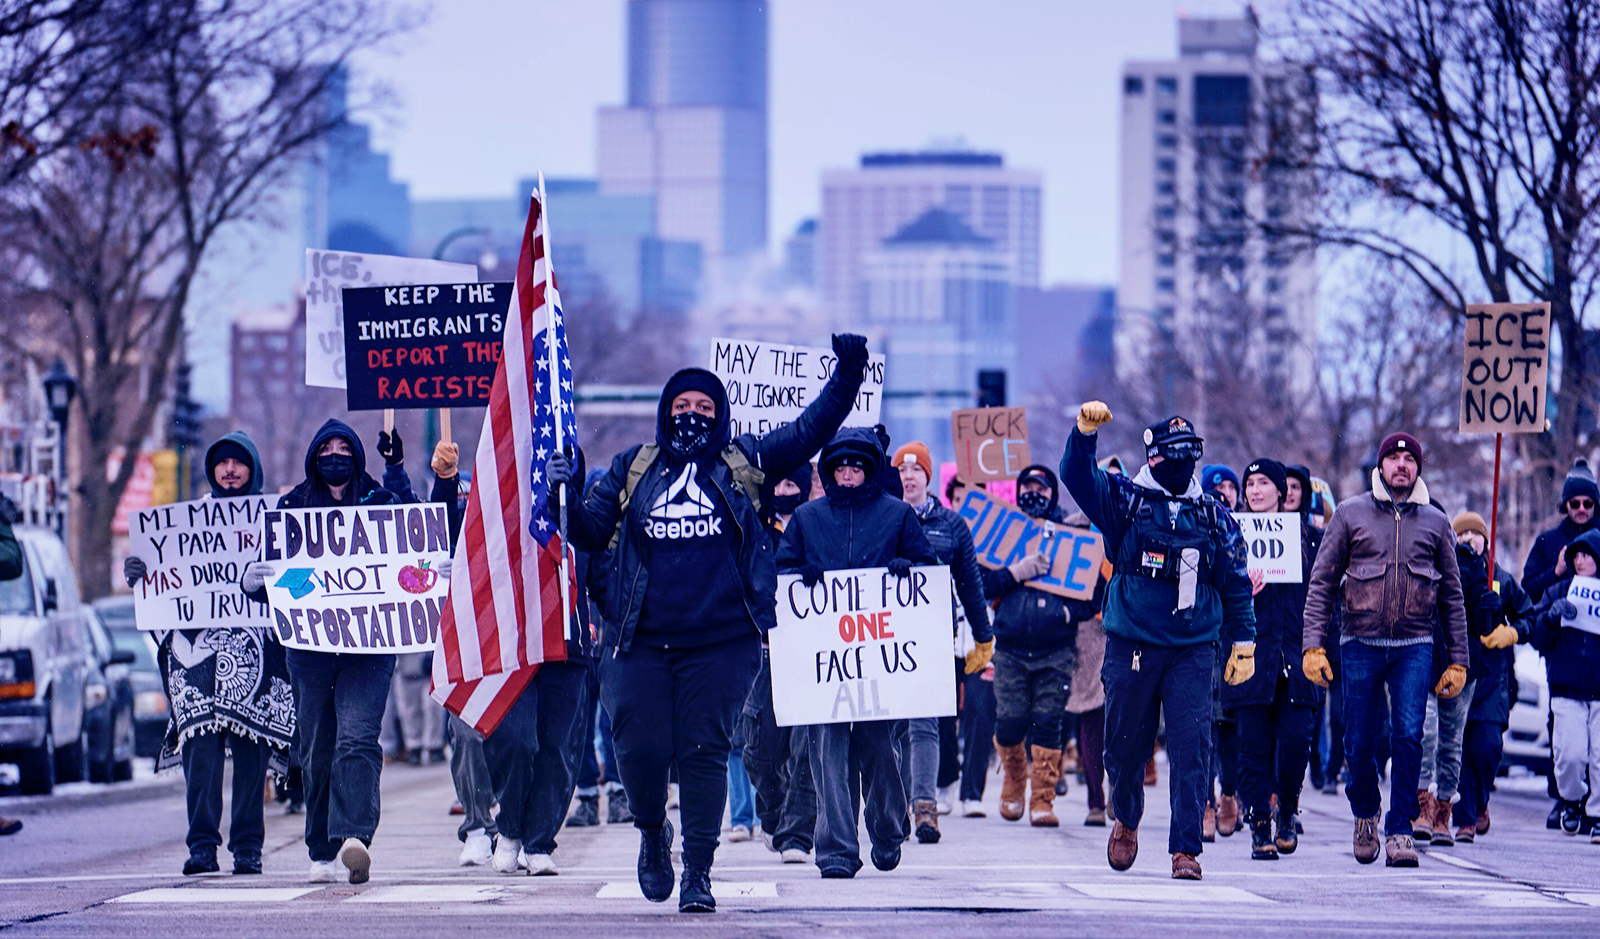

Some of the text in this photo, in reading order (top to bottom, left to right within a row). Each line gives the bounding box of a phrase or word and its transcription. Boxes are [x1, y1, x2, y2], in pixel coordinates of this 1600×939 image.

[307, 278, 343, 304] th
[384, 283, 496, 306] KEEP THE
[358, 313, 502, 341] IMMIGRANTS
[1466, 309, 1545, 349] ICE
[368, 344, 448, 368] DEPORT
[462, 341, 502, 363] THE
[715, 342, 884, 384] MAY THE SCMS
[378, 375, 491, 399] RACISTS
[1466, 358, 1542, 385] OUT
[752, 384, 808, 408] IGNORE
[1465, 385, 1538, 424] NOW
[957, 412, 1025, 439] FUCK
[966, 438, 1026, 476] ICE
[138, 498, 268, 533] MI MAMA
[643, 515, 722, 540] Reebok
[959, 491, 1040, 567] FUCK
[1253, 518, 1283, 531] WAS
[150, 536, 167, 564] Y
[178, 532, 226, 557] PAPA
[264, 506, 449, 561] EDUCATION
[143, 570, 183, 599] MAS
[191, 561, 240, 587] DURO
[322, 564, 388, 593] NOT
[170, 597, 194, 622] TU
[788, 571, 931, 619] COME FOR
[273, 596, 447, 649] DEPORTATION
[839, 611, 895, 643] ONE
[815, 640, 918, 684] FACE US
[831, 679, 890, 720] ALL
